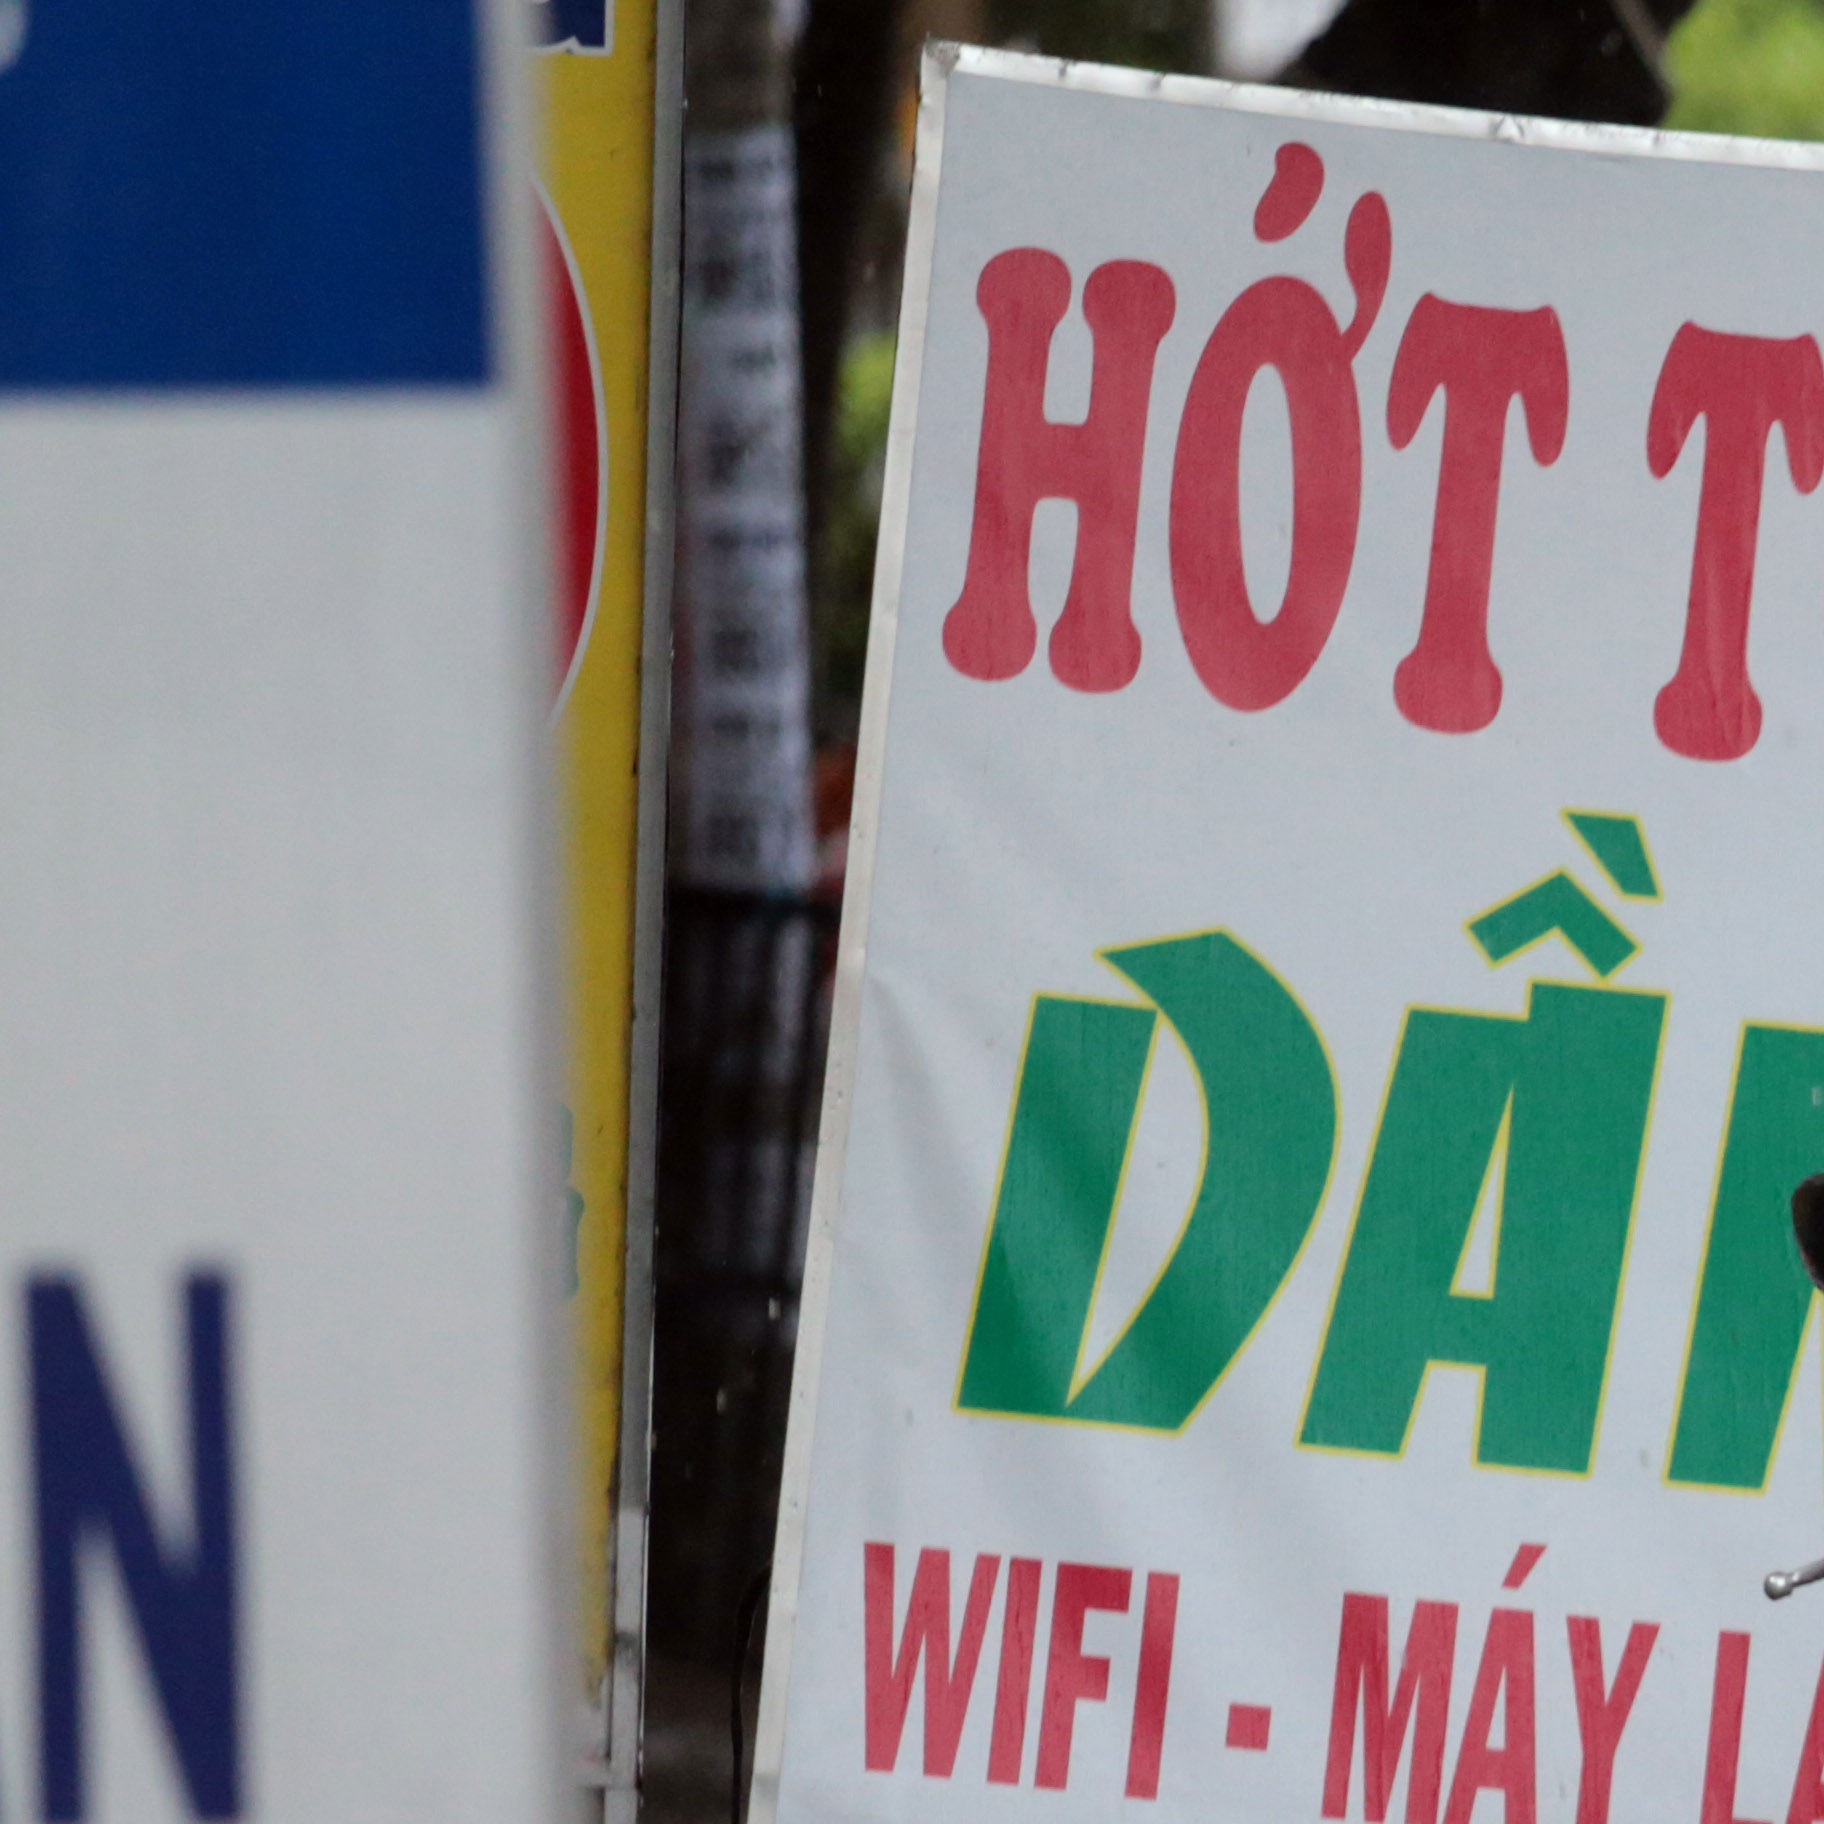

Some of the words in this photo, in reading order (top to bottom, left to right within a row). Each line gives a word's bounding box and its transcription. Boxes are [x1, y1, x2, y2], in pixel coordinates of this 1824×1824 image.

[941, 140, 1571, 735] HỚT
[863, 1541, 1181, 1801] WIFI
[1225, 1702, 1272, 1752] -
